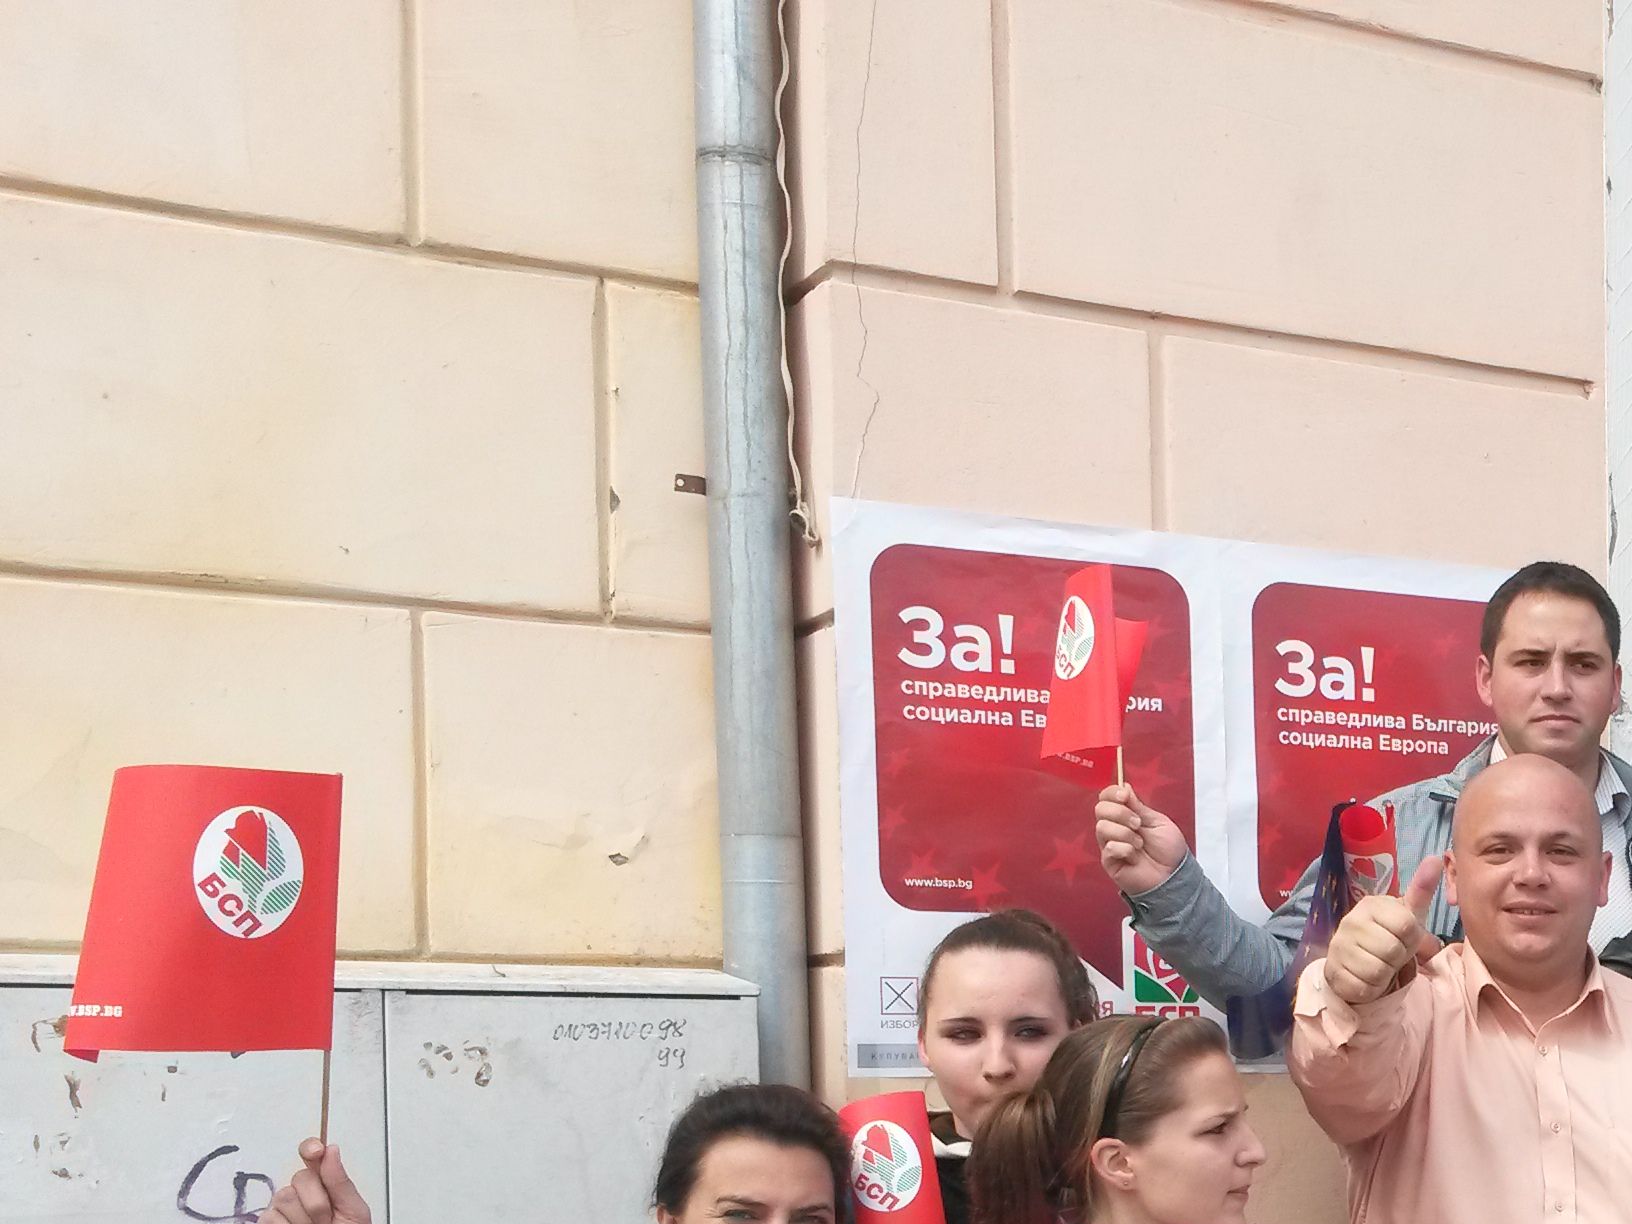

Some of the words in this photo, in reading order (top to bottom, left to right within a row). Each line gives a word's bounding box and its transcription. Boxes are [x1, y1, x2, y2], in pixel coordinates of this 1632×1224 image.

[897, 606, 1016, 674] За!
[1274, 639, 1375, 702] За!
[900, 679, 1050, 704] справедлива
[903, 704, 1013, 727] социална
[1277, 707, 1406, 729] справедлива
[1412, 714, 1498, 737] България
[1278, 729, 1373, 750] социална
[1379, 734, 1449, 755] Европа
[904, 877, 973, 891] www.bsp.bg
[197, 872, 262, 937] БСП
[854, 1173, 900, 1211] БСП
